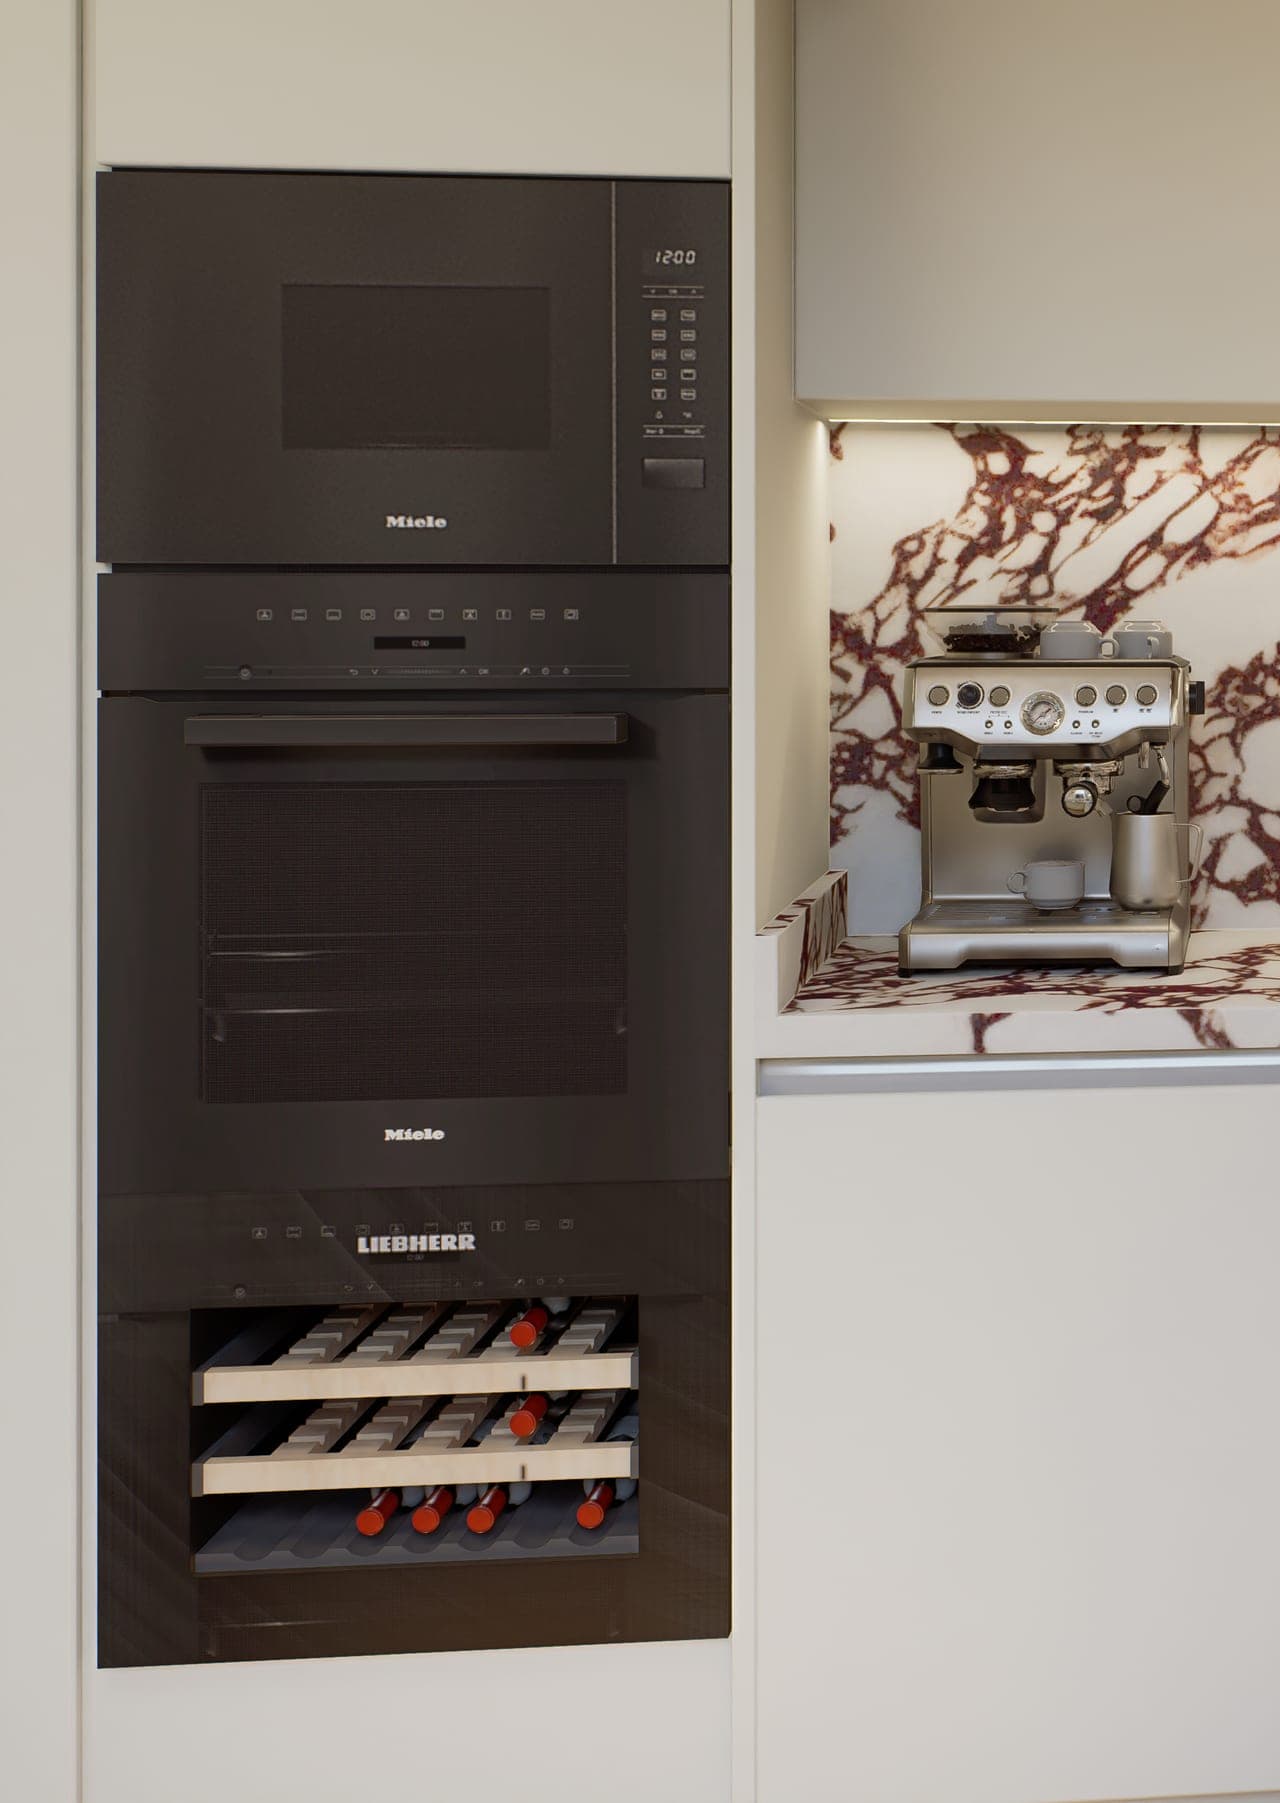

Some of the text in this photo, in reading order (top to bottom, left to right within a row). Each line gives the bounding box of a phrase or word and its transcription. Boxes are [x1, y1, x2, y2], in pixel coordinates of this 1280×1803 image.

[385, 515, 447, 528] Miele
[384, 1128, 445, 1141] Miele
[357, 1233, 477, 1254] LIEBHERR
